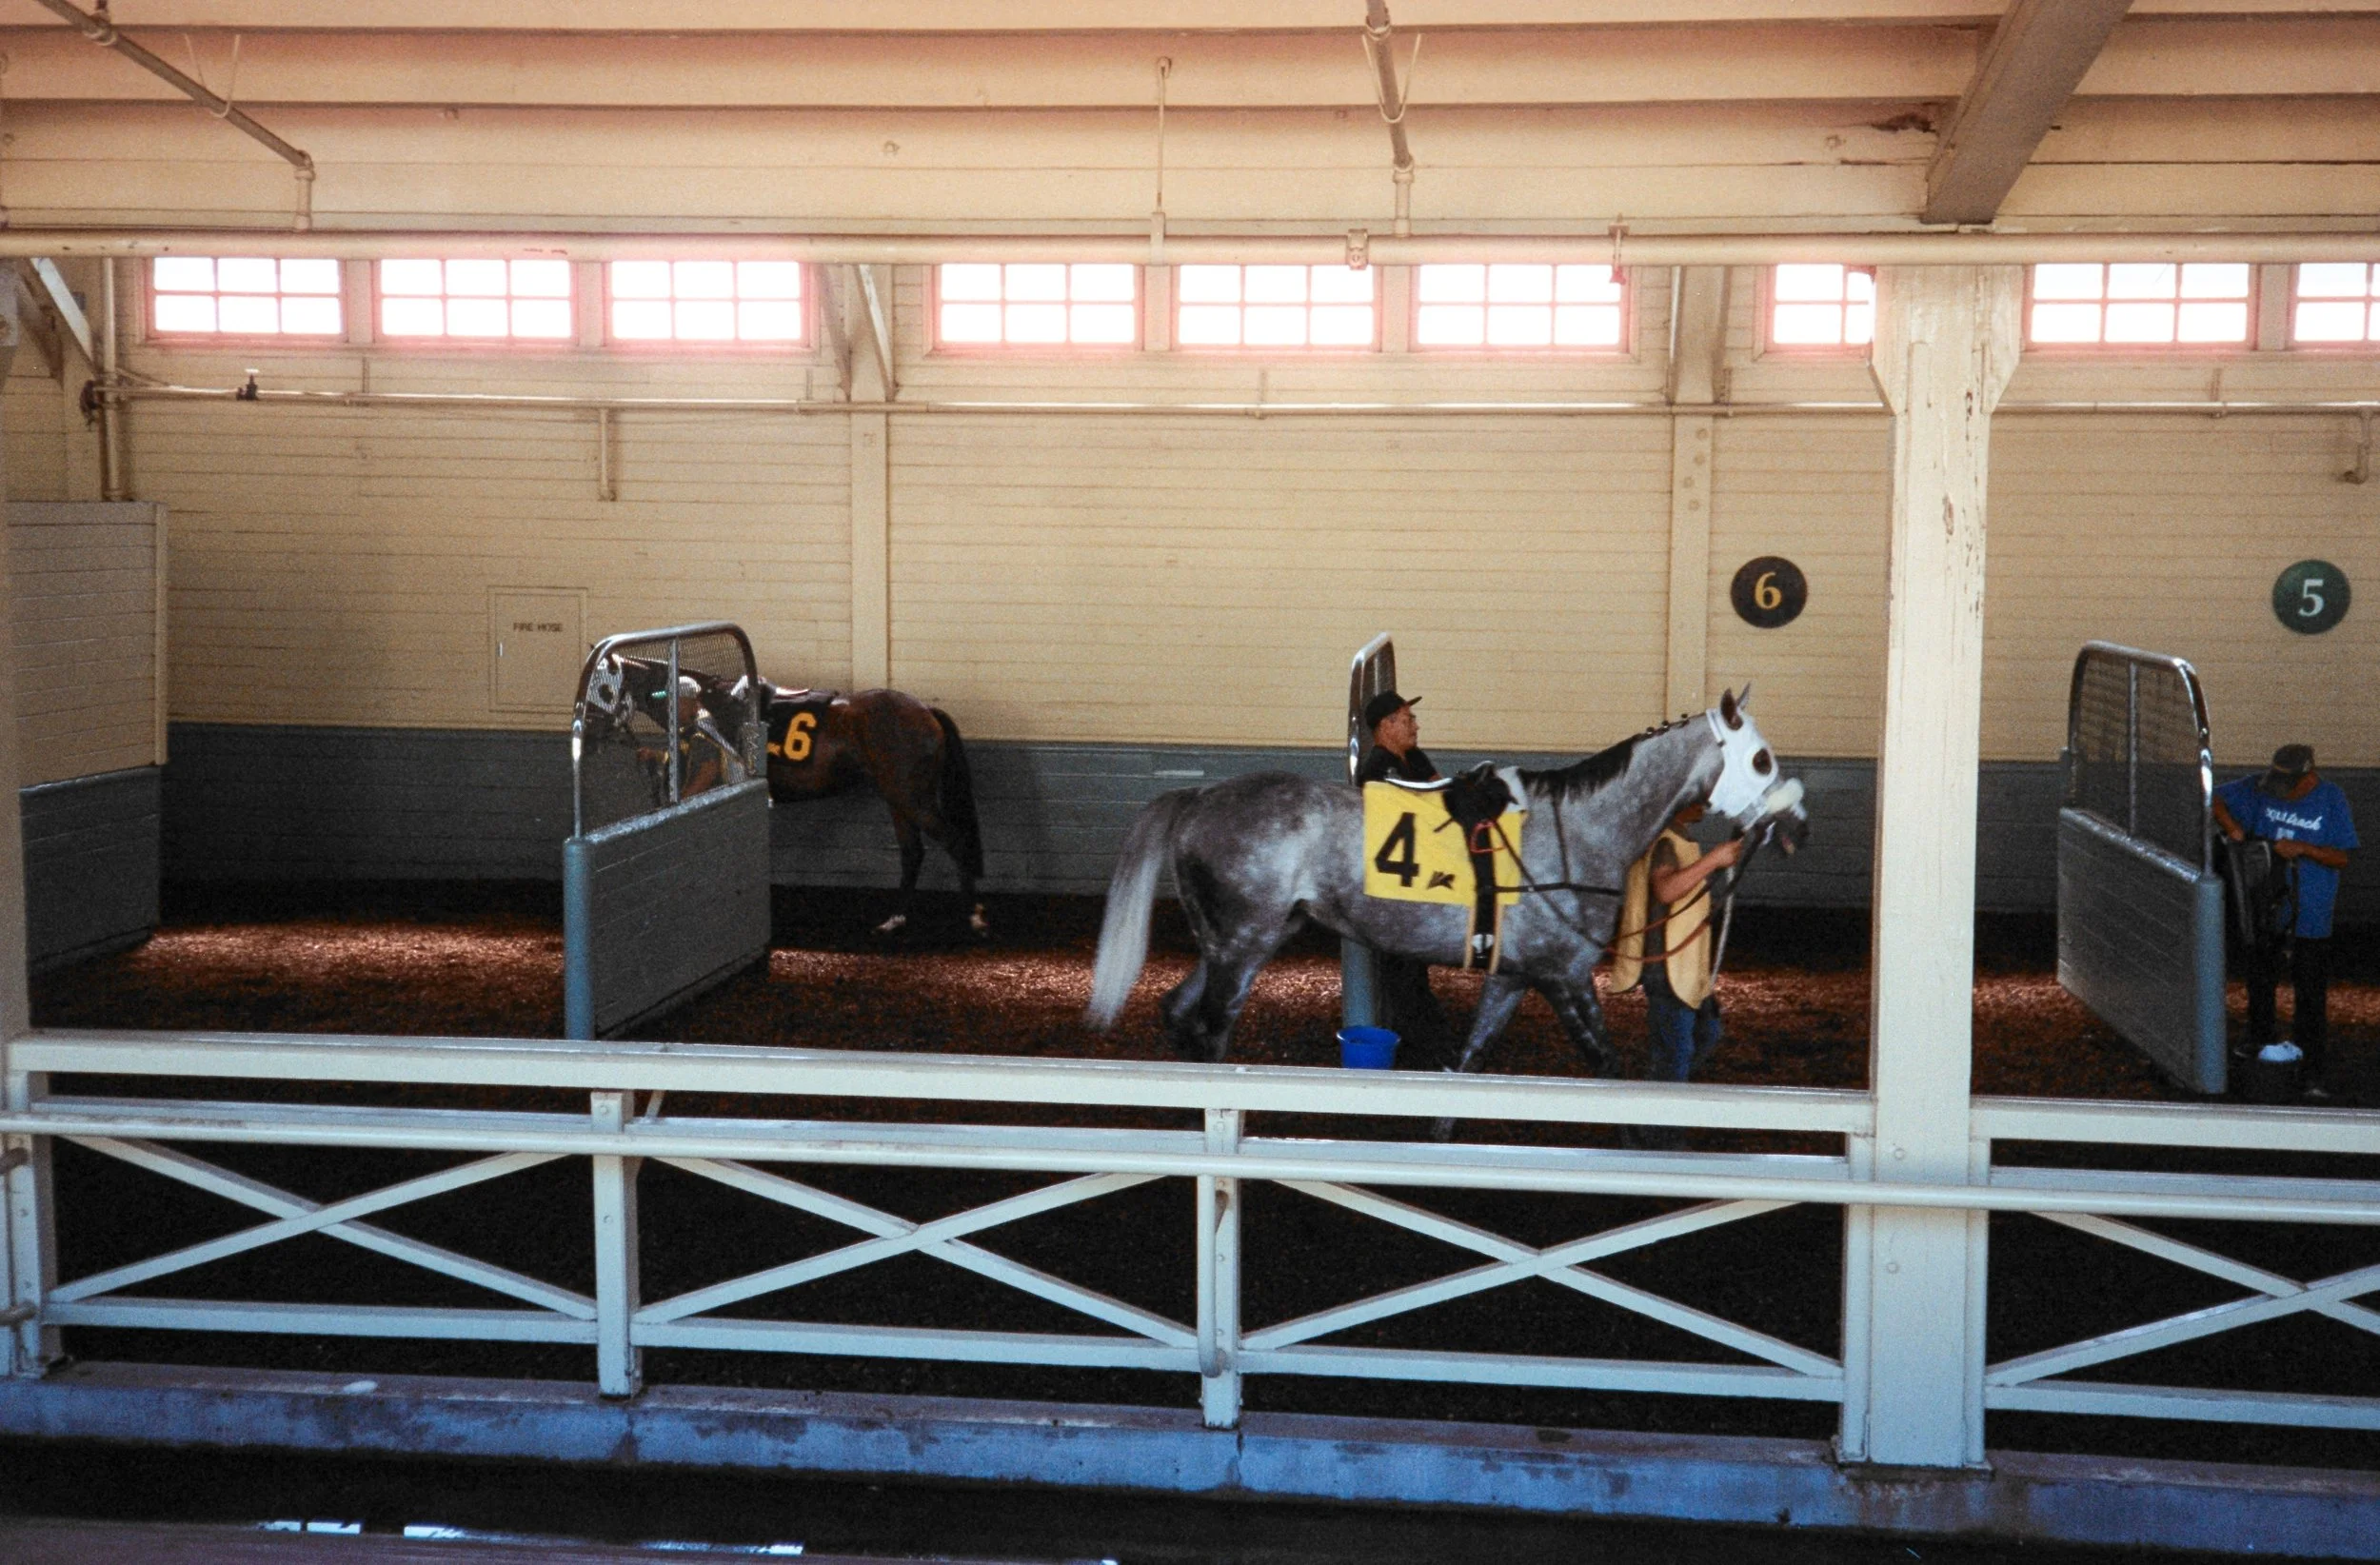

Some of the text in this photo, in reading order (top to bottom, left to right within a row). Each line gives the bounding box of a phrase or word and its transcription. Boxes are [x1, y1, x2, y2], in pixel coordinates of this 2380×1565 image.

[1755, 571, 1781, 609] 6
[2298, 578, 2324, 617] 5
[512, 622, 533, 632] FIRE
[783, 712, 817, 761] 6
[1374, 811, 1420, 887] 4
